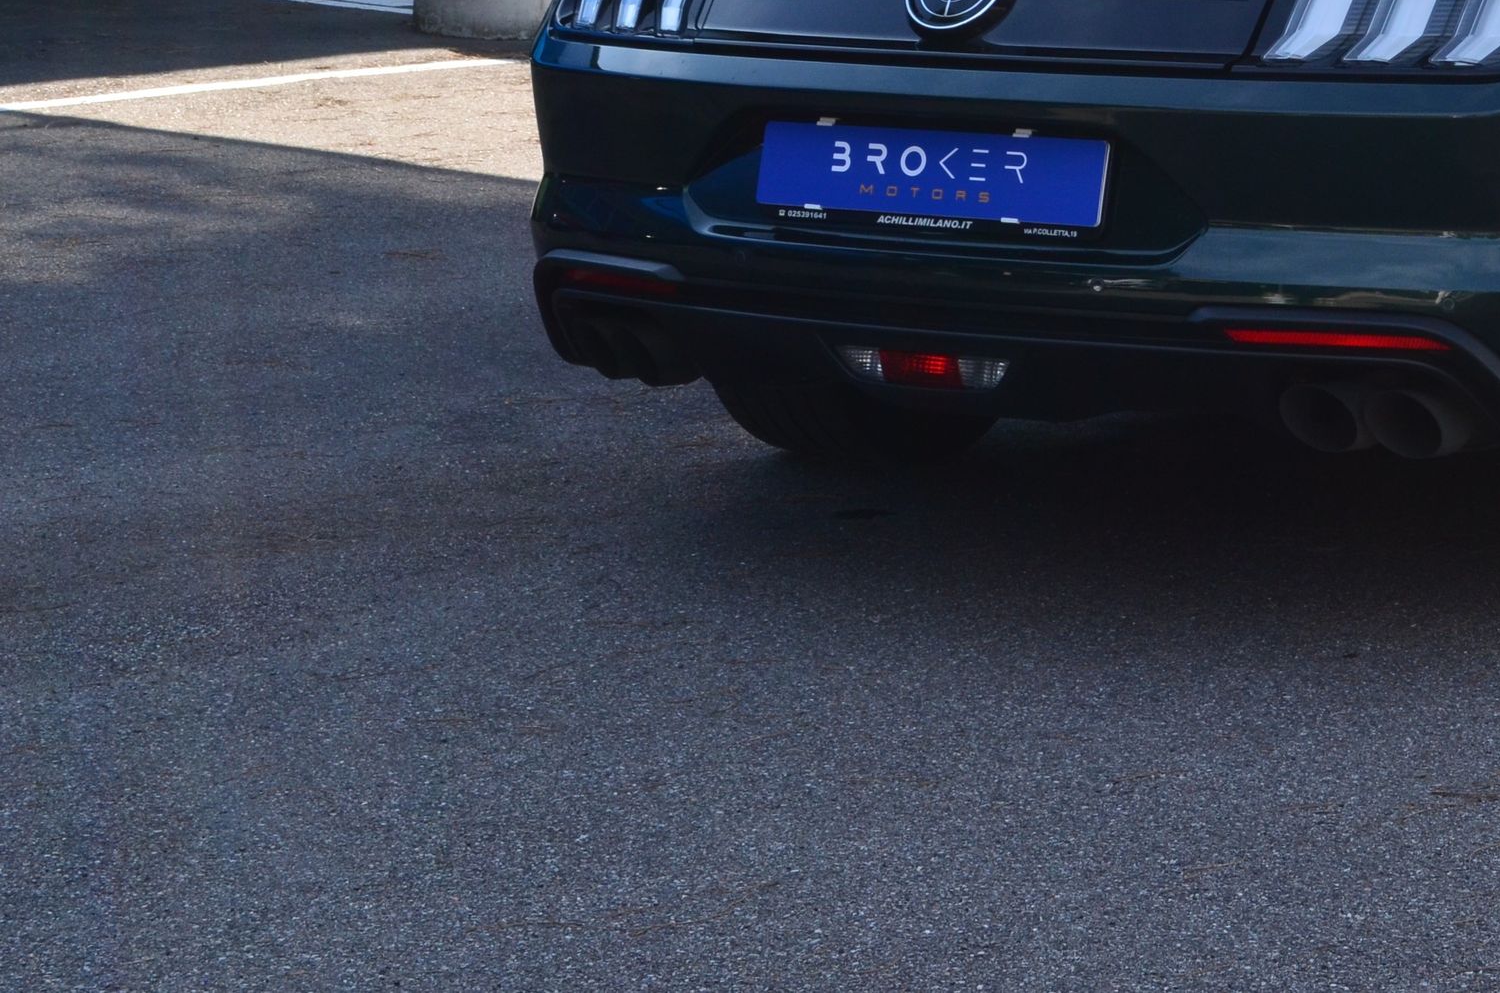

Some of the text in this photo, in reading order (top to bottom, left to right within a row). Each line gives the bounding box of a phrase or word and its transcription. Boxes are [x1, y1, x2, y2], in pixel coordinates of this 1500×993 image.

[831, 140, 1028, 184] BROKER
[859, 184, 991, 204] MOTORS
[877, 214, 973, 229] ACHILLIMILANO.IT
